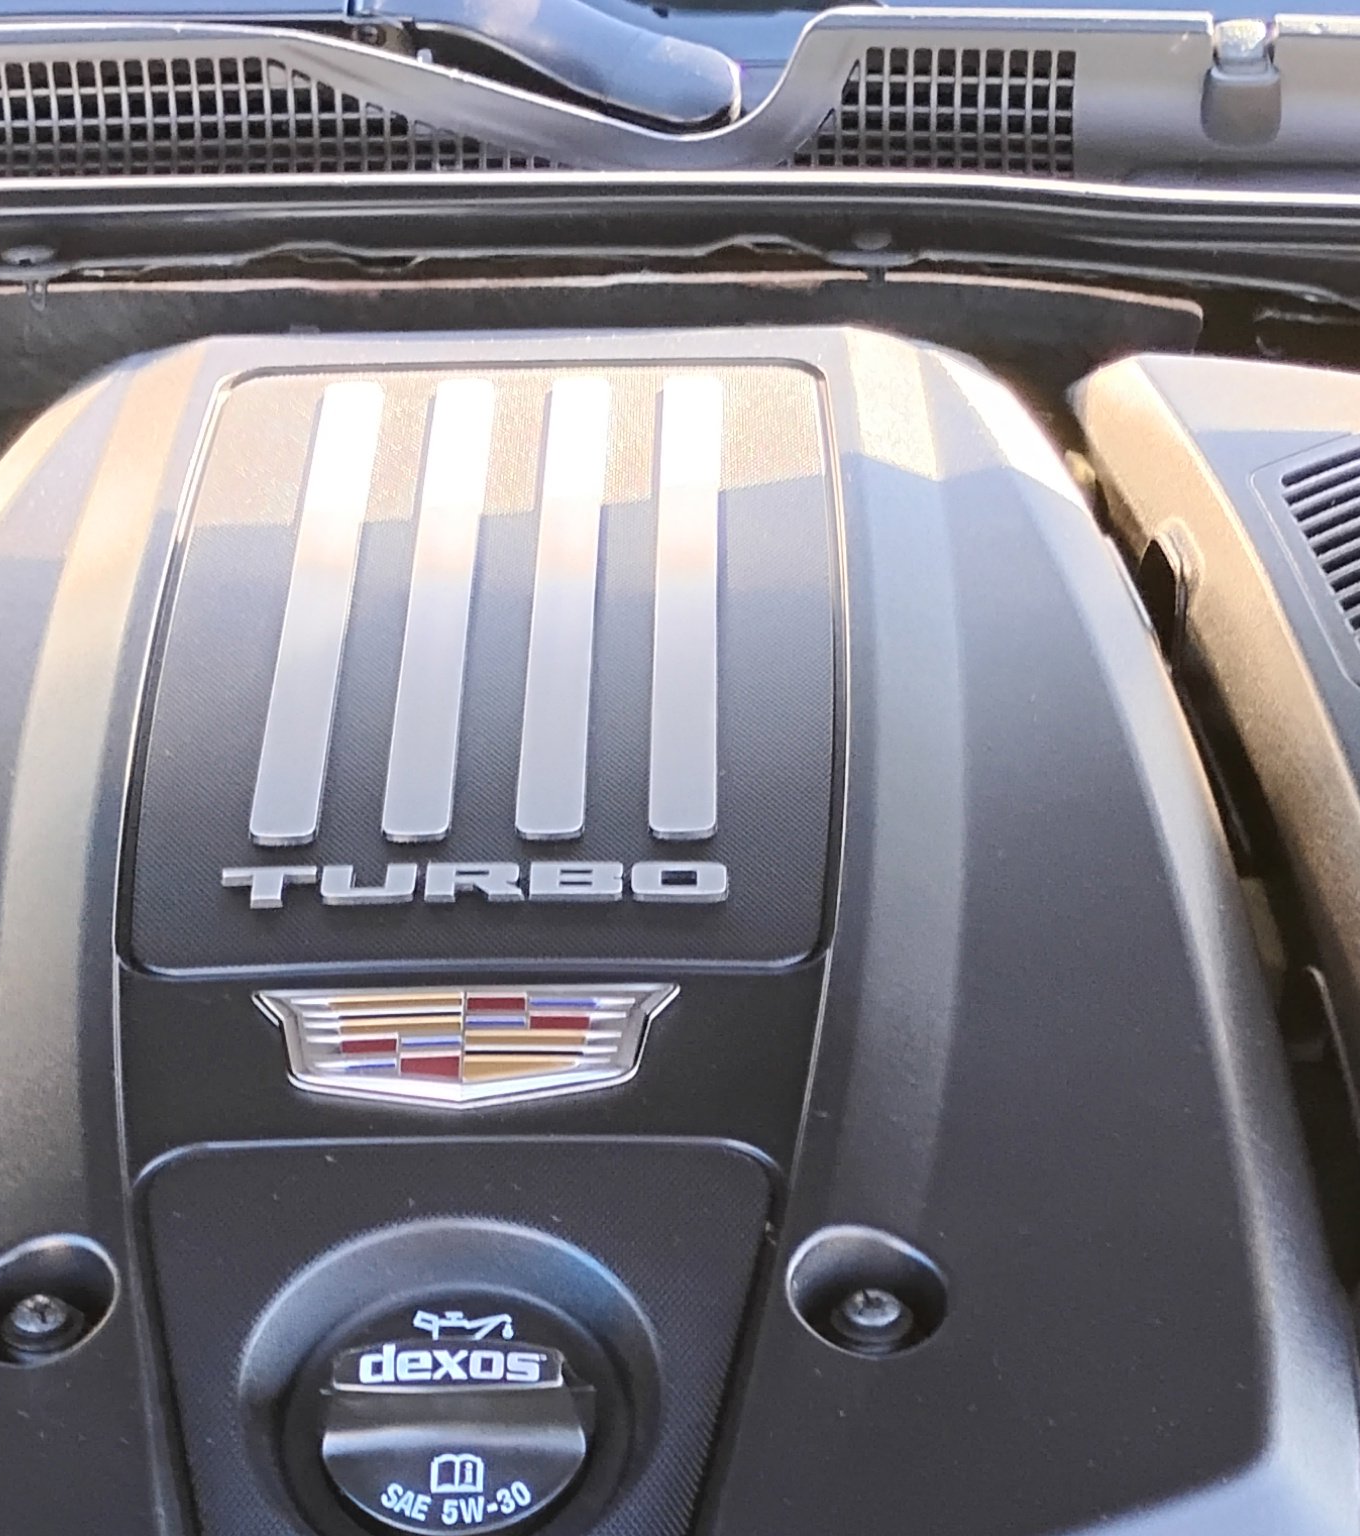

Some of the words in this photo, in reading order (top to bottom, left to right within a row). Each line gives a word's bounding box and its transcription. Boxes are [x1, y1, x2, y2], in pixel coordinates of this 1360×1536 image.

[221, 860, 729, 909] TURBO
[358, 1343, 547, 1384] dexos
[380, 1483, 432, 1521] SAE
[441, 1480, 531, 1525] 5W-30
